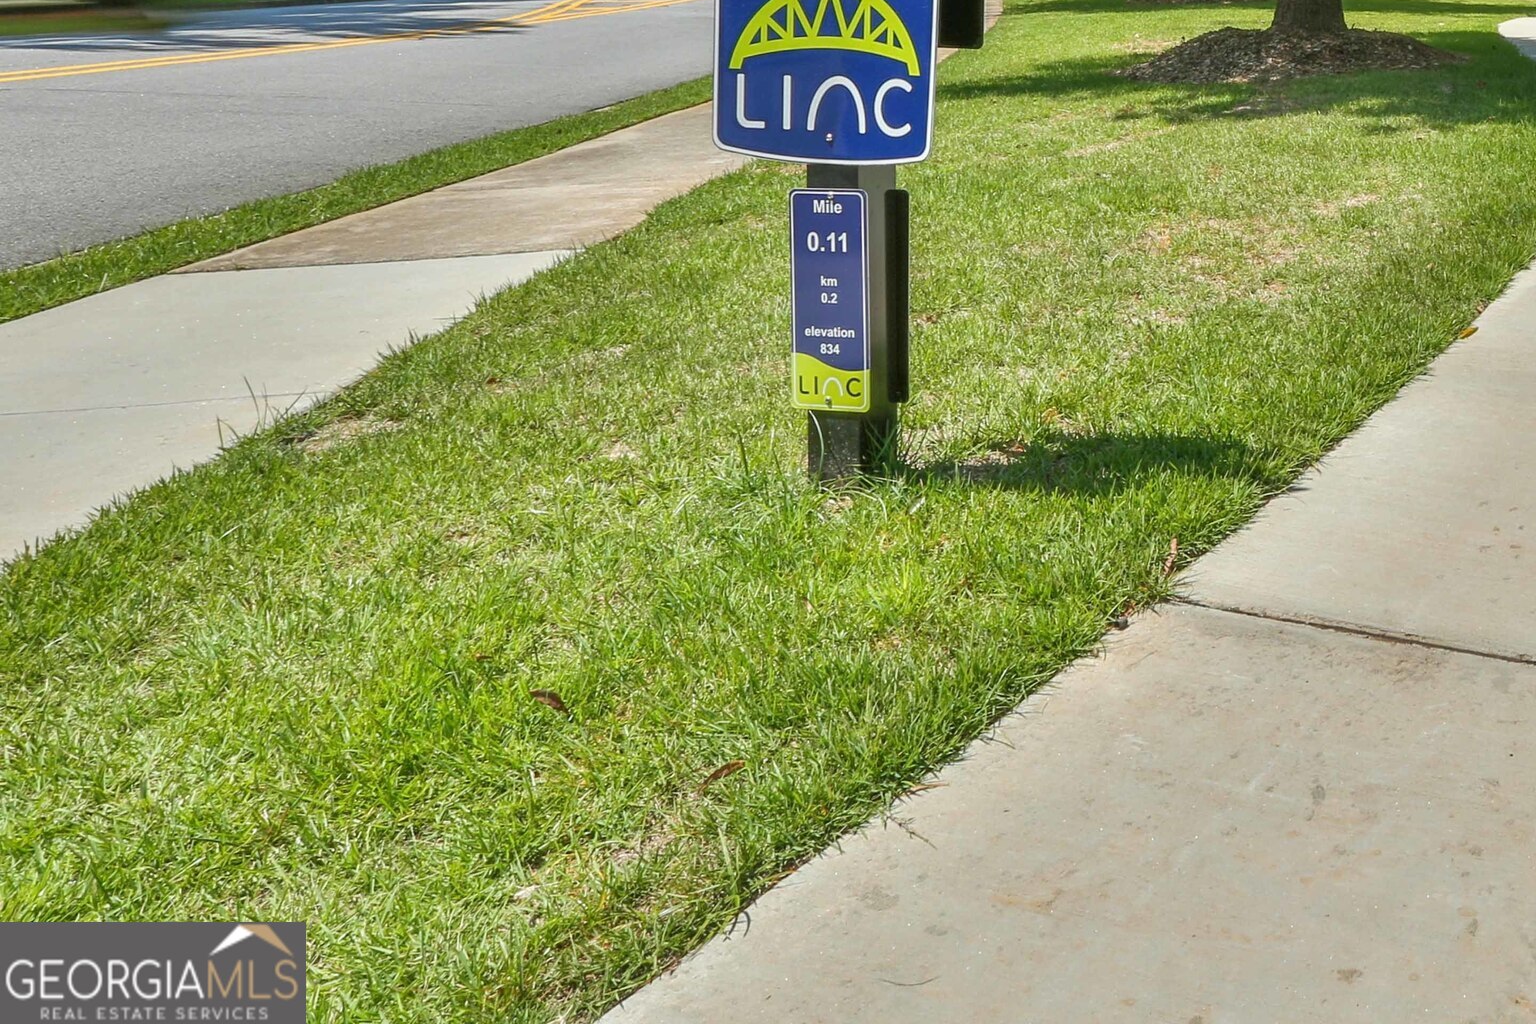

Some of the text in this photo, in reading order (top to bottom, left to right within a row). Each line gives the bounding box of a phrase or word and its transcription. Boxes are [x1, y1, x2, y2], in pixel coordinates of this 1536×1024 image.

[813, 199, 843, 214] Mile
[806, 231, 848, 253] 0.11
[820, 275, 838, 287] km
[820, 293, 838, 304] 0.2
[804, 326, 855, 338] elevation
[820, 343, 840, 355] 834
